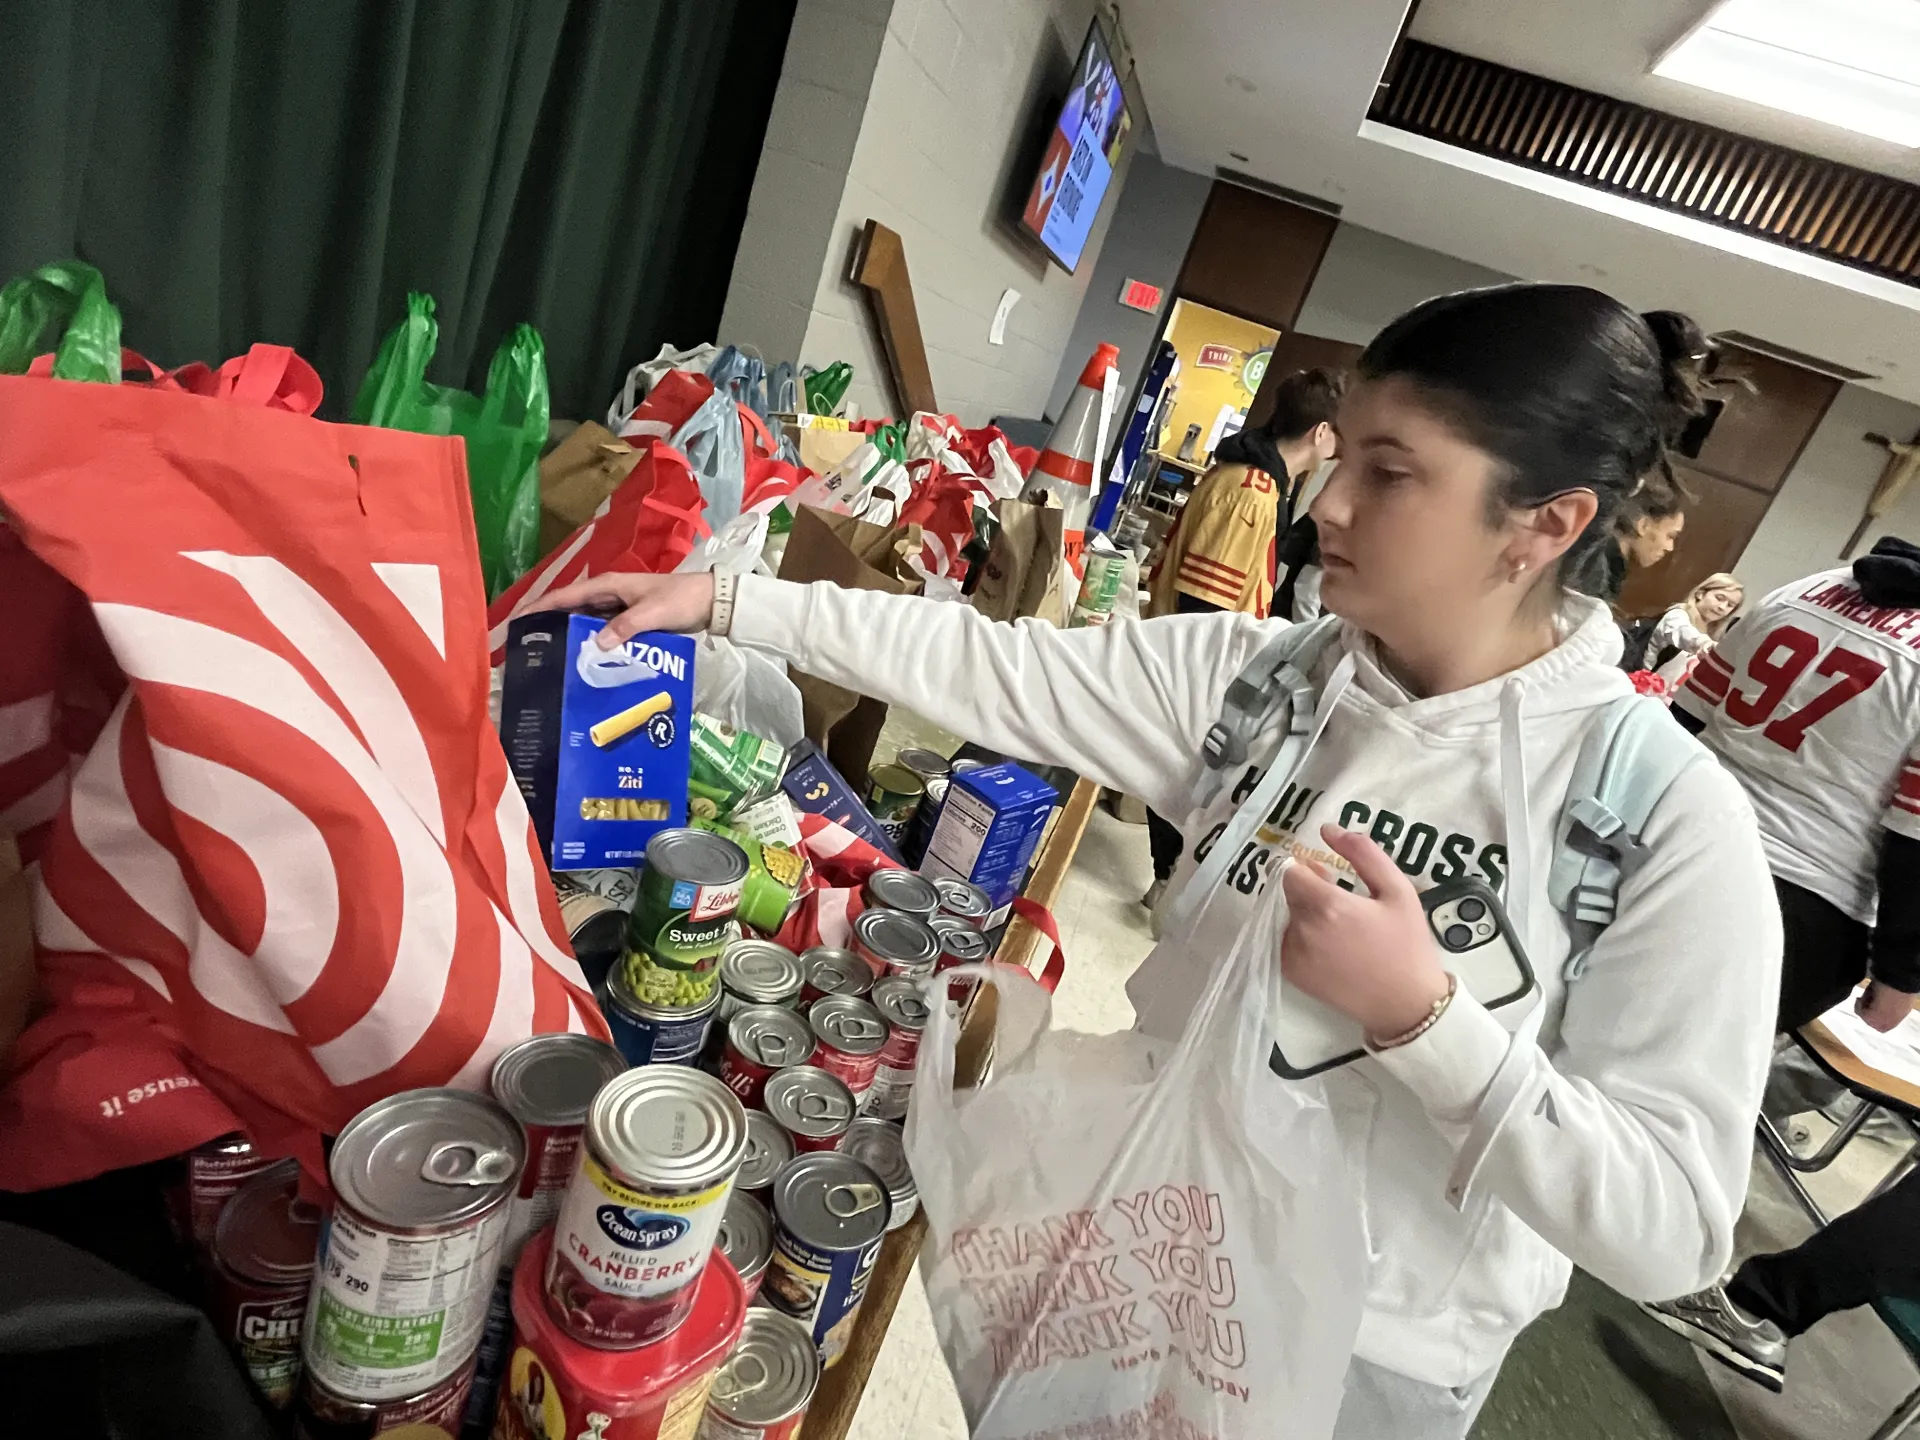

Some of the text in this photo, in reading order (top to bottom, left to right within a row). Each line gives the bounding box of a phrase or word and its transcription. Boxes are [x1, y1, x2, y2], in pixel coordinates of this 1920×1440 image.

[1208, 351, 1234, 364] THINK
[1241, 467, 1272, 494] 19
[620, 640, 687, 681] NZONI
[1725, 624, 1887, 753] 97
[618, 766, 635, 774] NO.
[618, 775, 643, 790] Ziti
[970, 818, 986, 836] 200
[669, 927, 719, 942] Sweet
[102, 1097, 124, 1118] it
[619, 1192, 651, 1208] RECIPE
[601, 1211, 678, 1248] Ocean Spray
[951, 1184, 1225, 1273] THANK YOU
[568, 1232, 700, 1282] CRANBERRY
[607, 1250, 658, 1265] JELLIED
[346, 1274, 369, 1293] 290
[1130, 1240, 1236, 1308] YOU
[604, 1277, 645, 1293] SAUCE
[1148, 1290, 1247, 1370] YOU
